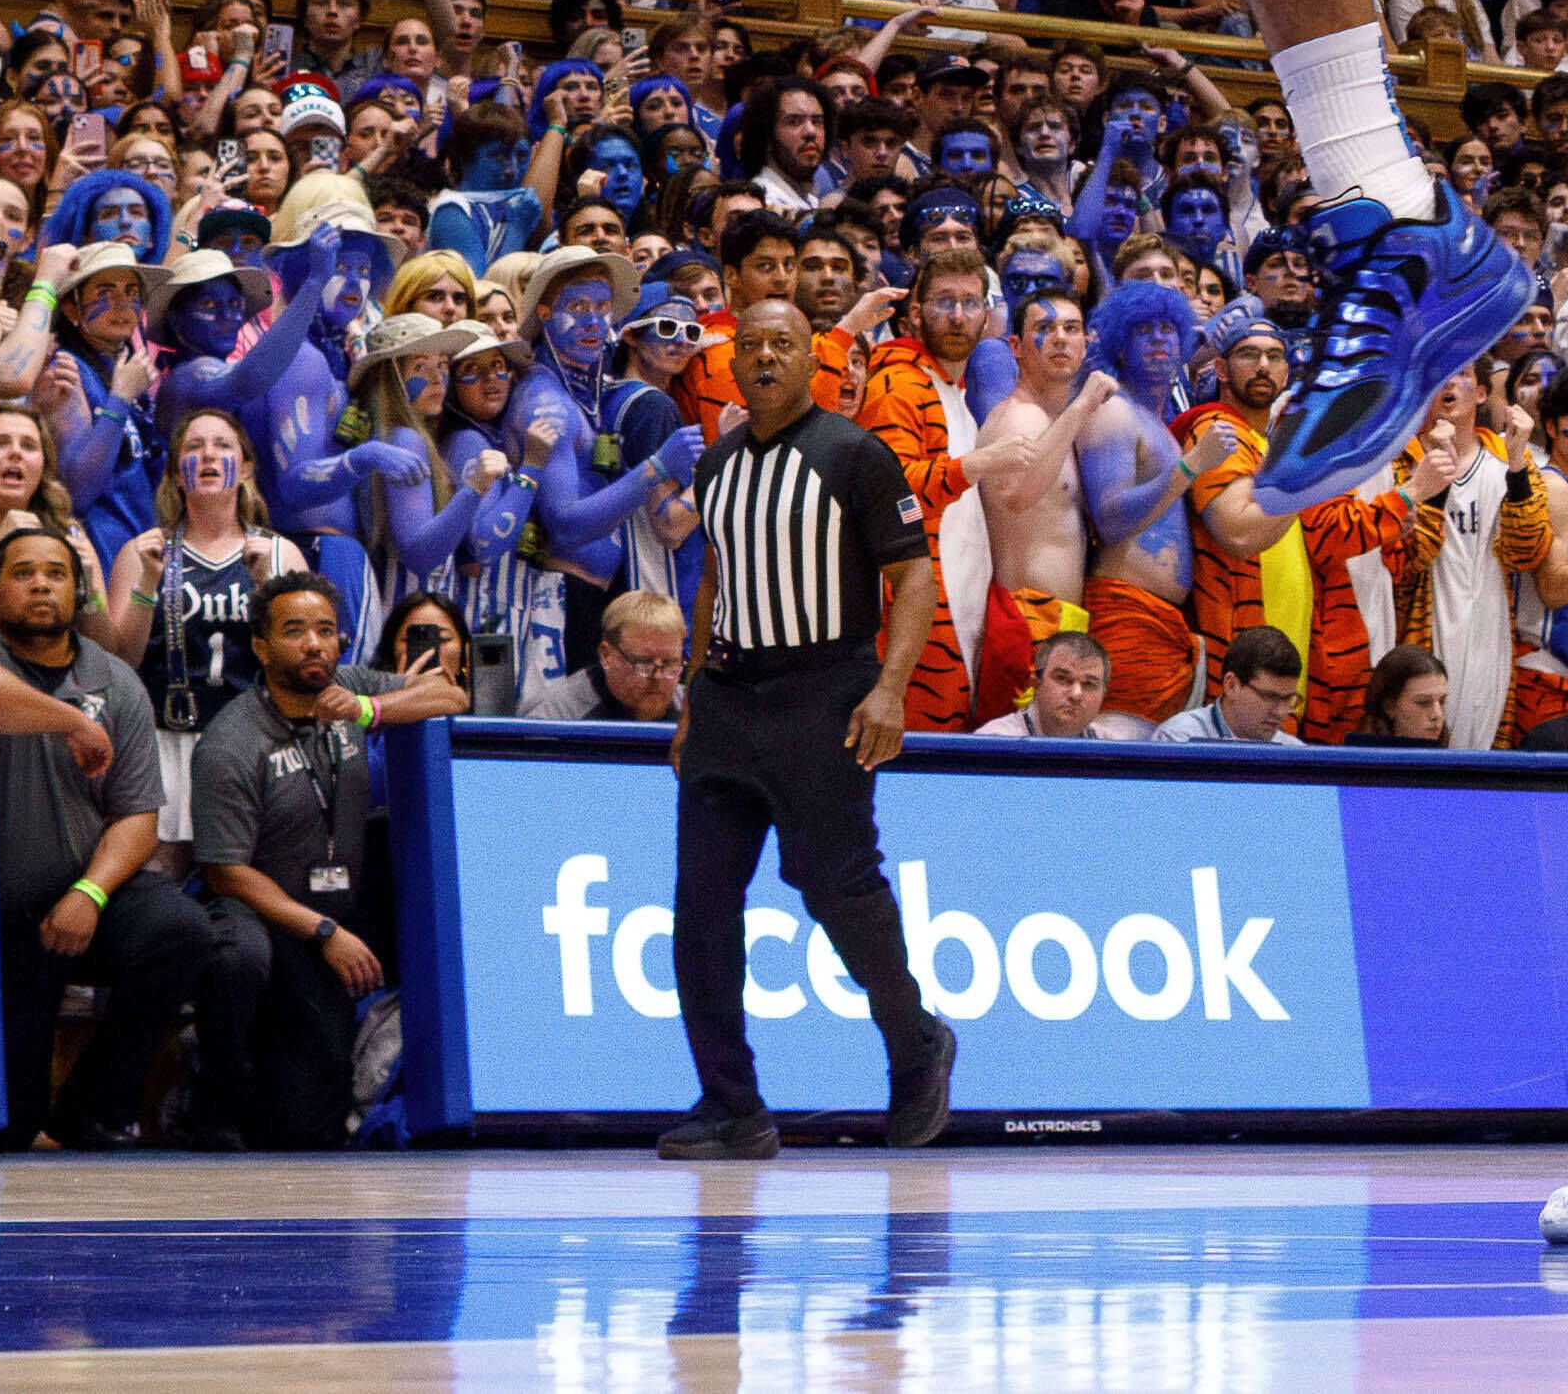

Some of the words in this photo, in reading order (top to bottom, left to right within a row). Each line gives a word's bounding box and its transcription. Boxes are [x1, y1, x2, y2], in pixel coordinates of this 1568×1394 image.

[183, 581, 250, 624] Duk
[208, 632, 225, 686] 1
[1004, 1120, 1102, 1133] DAKTRONICS
